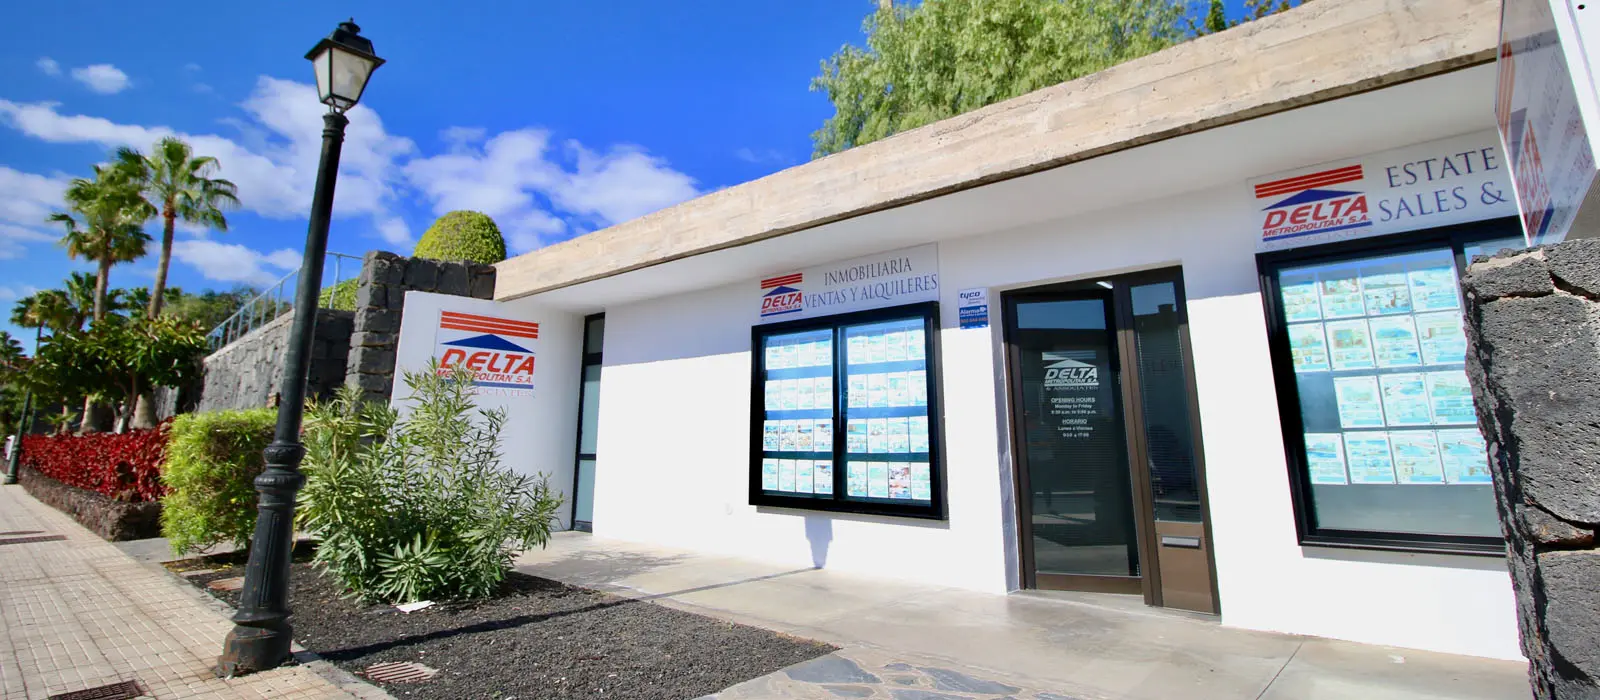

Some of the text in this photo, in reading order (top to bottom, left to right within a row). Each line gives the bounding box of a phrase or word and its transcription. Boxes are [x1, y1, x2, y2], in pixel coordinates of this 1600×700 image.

[1386, 147, 1498, 188] ESTATE
[1262, 196, 1368, 230] DELTA
[1378, 181, 1508, 222] SALES &
[1262, 218, 1344, 238] METROPOLITAN
[1348, 214, 1370, 224] S.A.
[824, 257, 912, 286] INMOBILIARIA
[762, 292, 802, 310] DELTA
[804, 274, 938, 309] VENTAS Y ALQUILERES
[960, 292, 980, 300] tyco
[436, 368, 533, 384] MEPOLITAN S.A.
[439, 348, 536, 376] DELTA
[1044, 367, 1098, 379] DELTA
